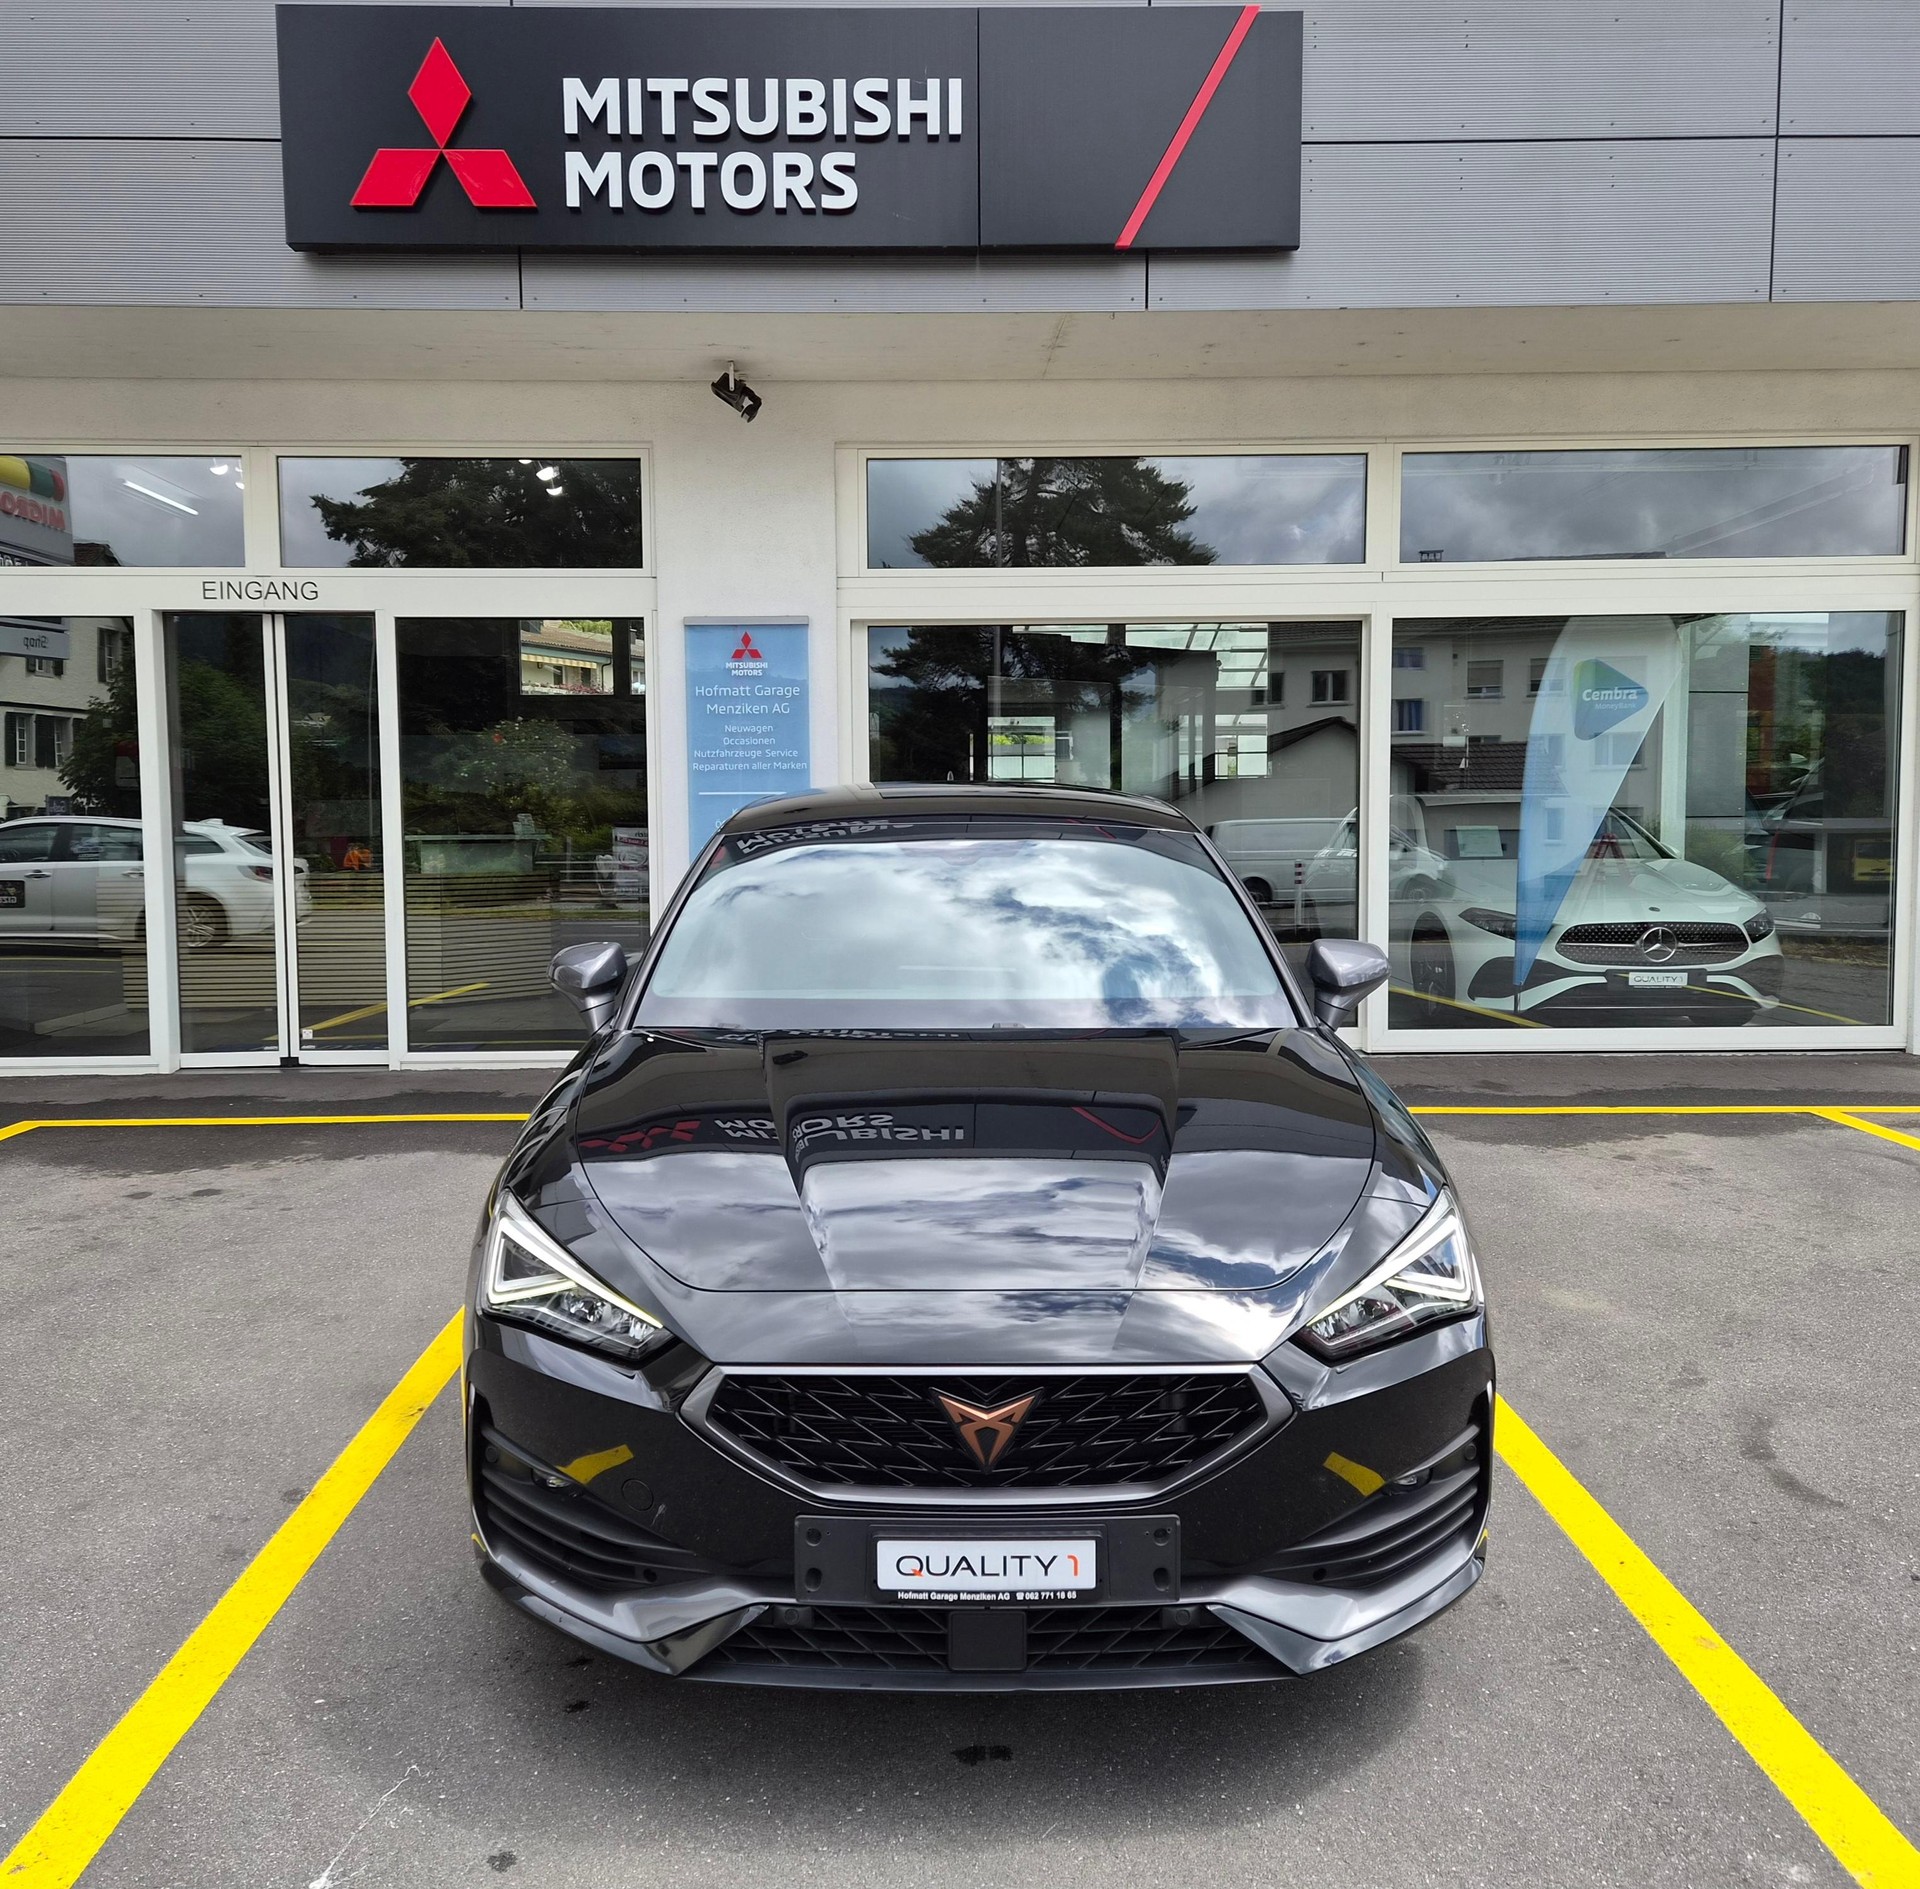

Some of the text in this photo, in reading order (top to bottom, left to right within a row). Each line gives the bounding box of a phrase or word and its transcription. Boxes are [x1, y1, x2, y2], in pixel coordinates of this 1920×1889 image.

[562, 77, 963, 136] MITSUBISHI
[564, 150, 860, 210] MOTORS
[202, 580, 319, 601] EINGANG
[725, 661, 769, 669] MITSUBISHI
[731, 669, 763, 677] MOTORS
[695, 684, 801, 699] Hofmatt Garage
[1582, 686, 1638, 701] Cembra
[706, 702, 791, 715] Menziken AG
[724, 724, 774, 735] Neuwagen
[722, 736, 776, 746] Occasionen
[694, 748, 799, 759] Nutzfahrzeuge Service
[692, 761, 808, 772] Reparaturen aller Marken
[1634, 975, 1678, 983] QUALITY
[896, 1554, 1079, 1577] QUALITY 1
[897, 1591, 929, 1600] Hofmatt
[930, 1592, 958, 1602] Garage
[959, 1592, 997, 1601] Menziken
[998, 1592, 1011, 1601] AG
[1041, 1591, 1054, 1600] 771
